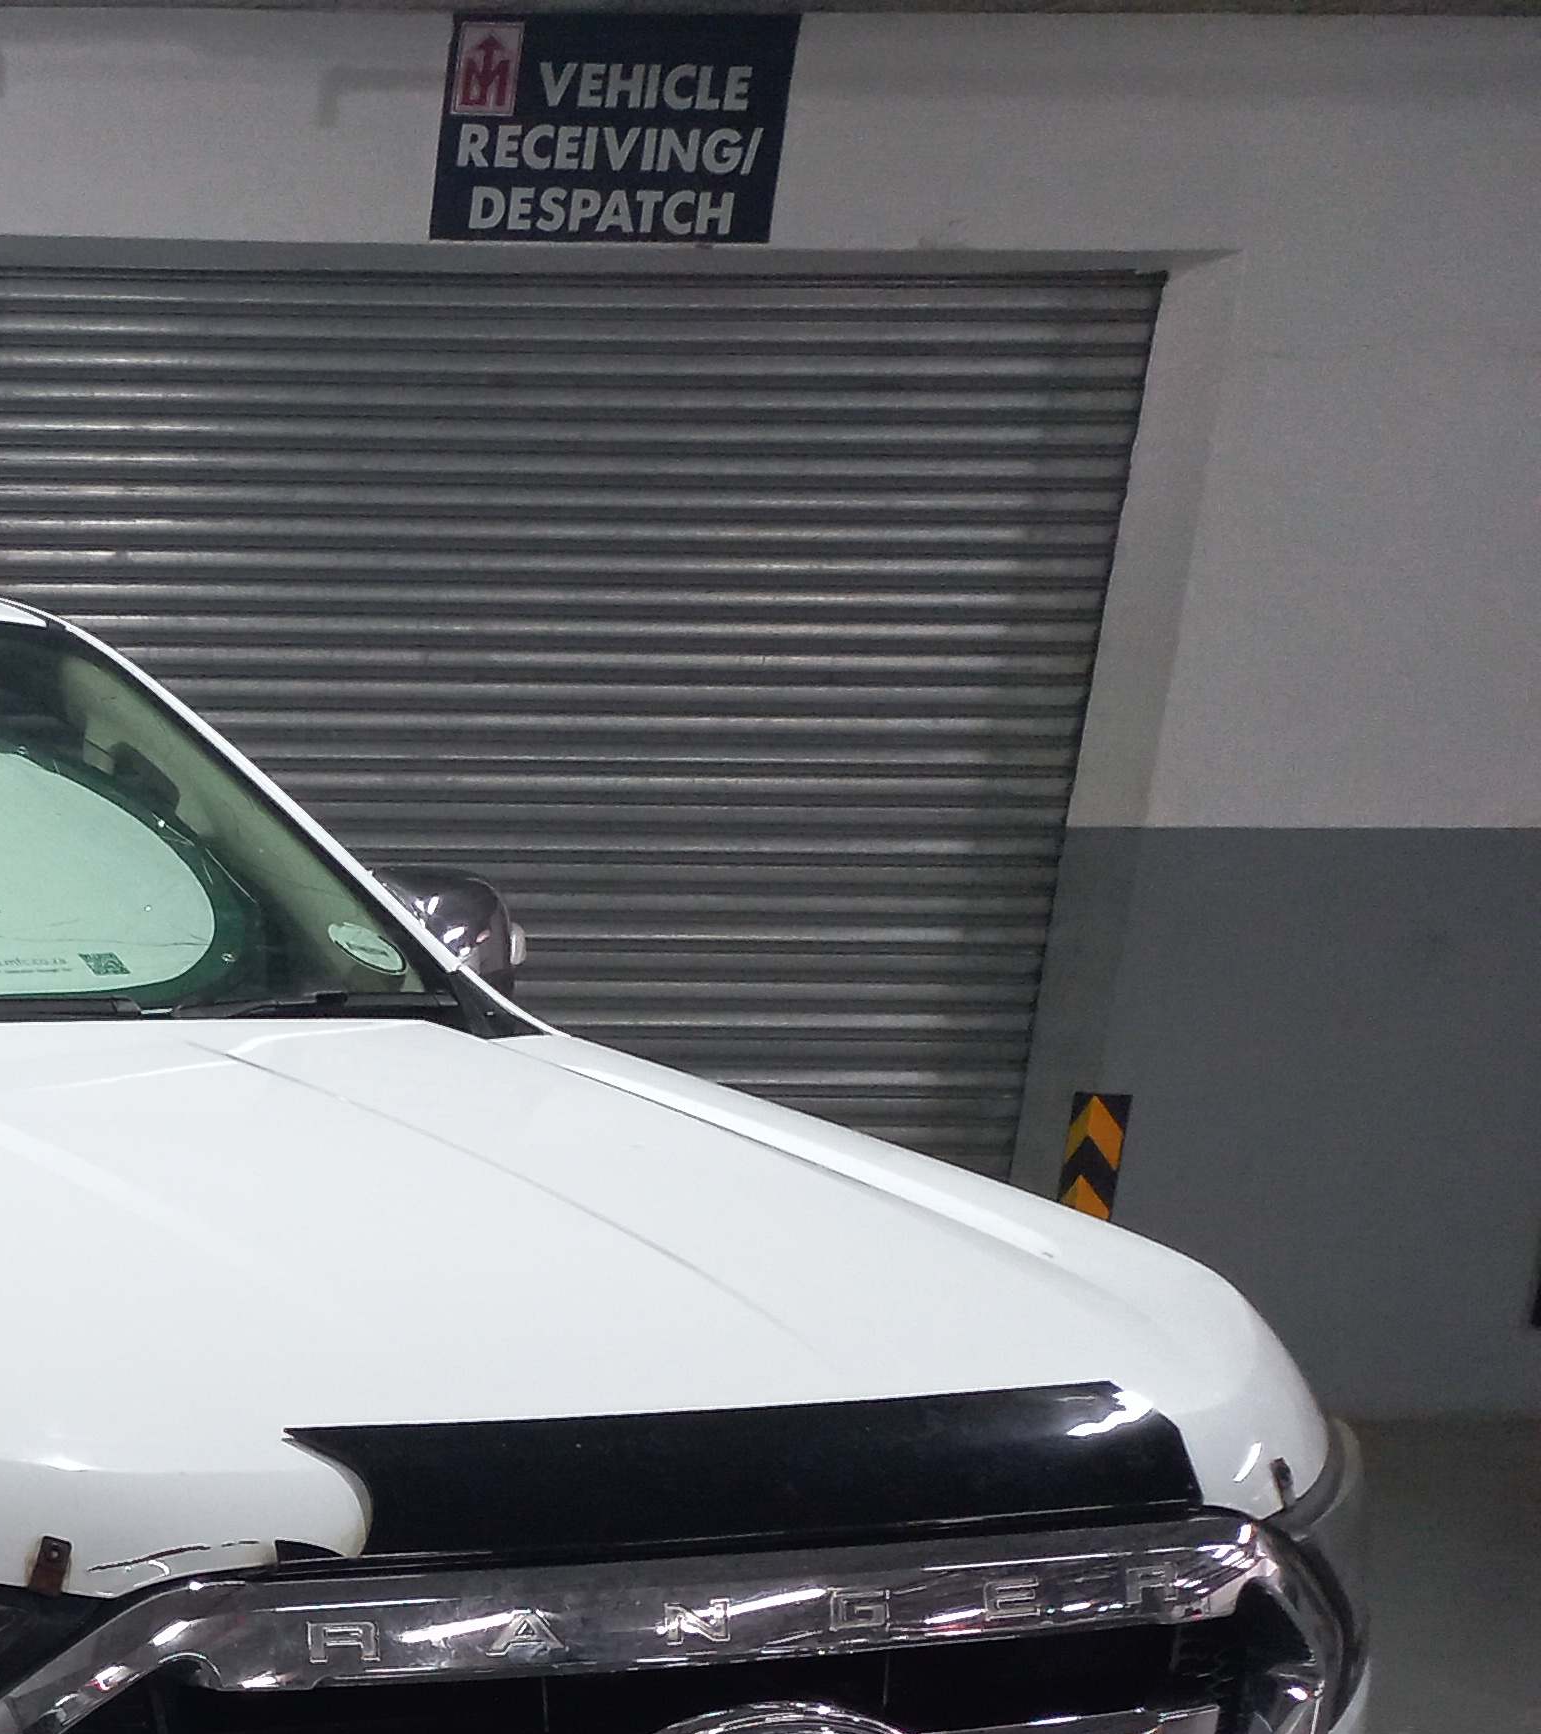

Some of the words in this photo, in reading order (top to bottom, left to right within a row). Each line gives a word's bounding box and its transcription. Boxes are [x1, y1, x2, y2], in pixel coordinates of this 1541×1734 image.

[539, 61, 753, 111] VEHICLE
[456, 123, 764, 176] RECEIVING/
[468, 186, 735, 235] DESPATCH
[307, 1560, 1179, 1664] RANGER
